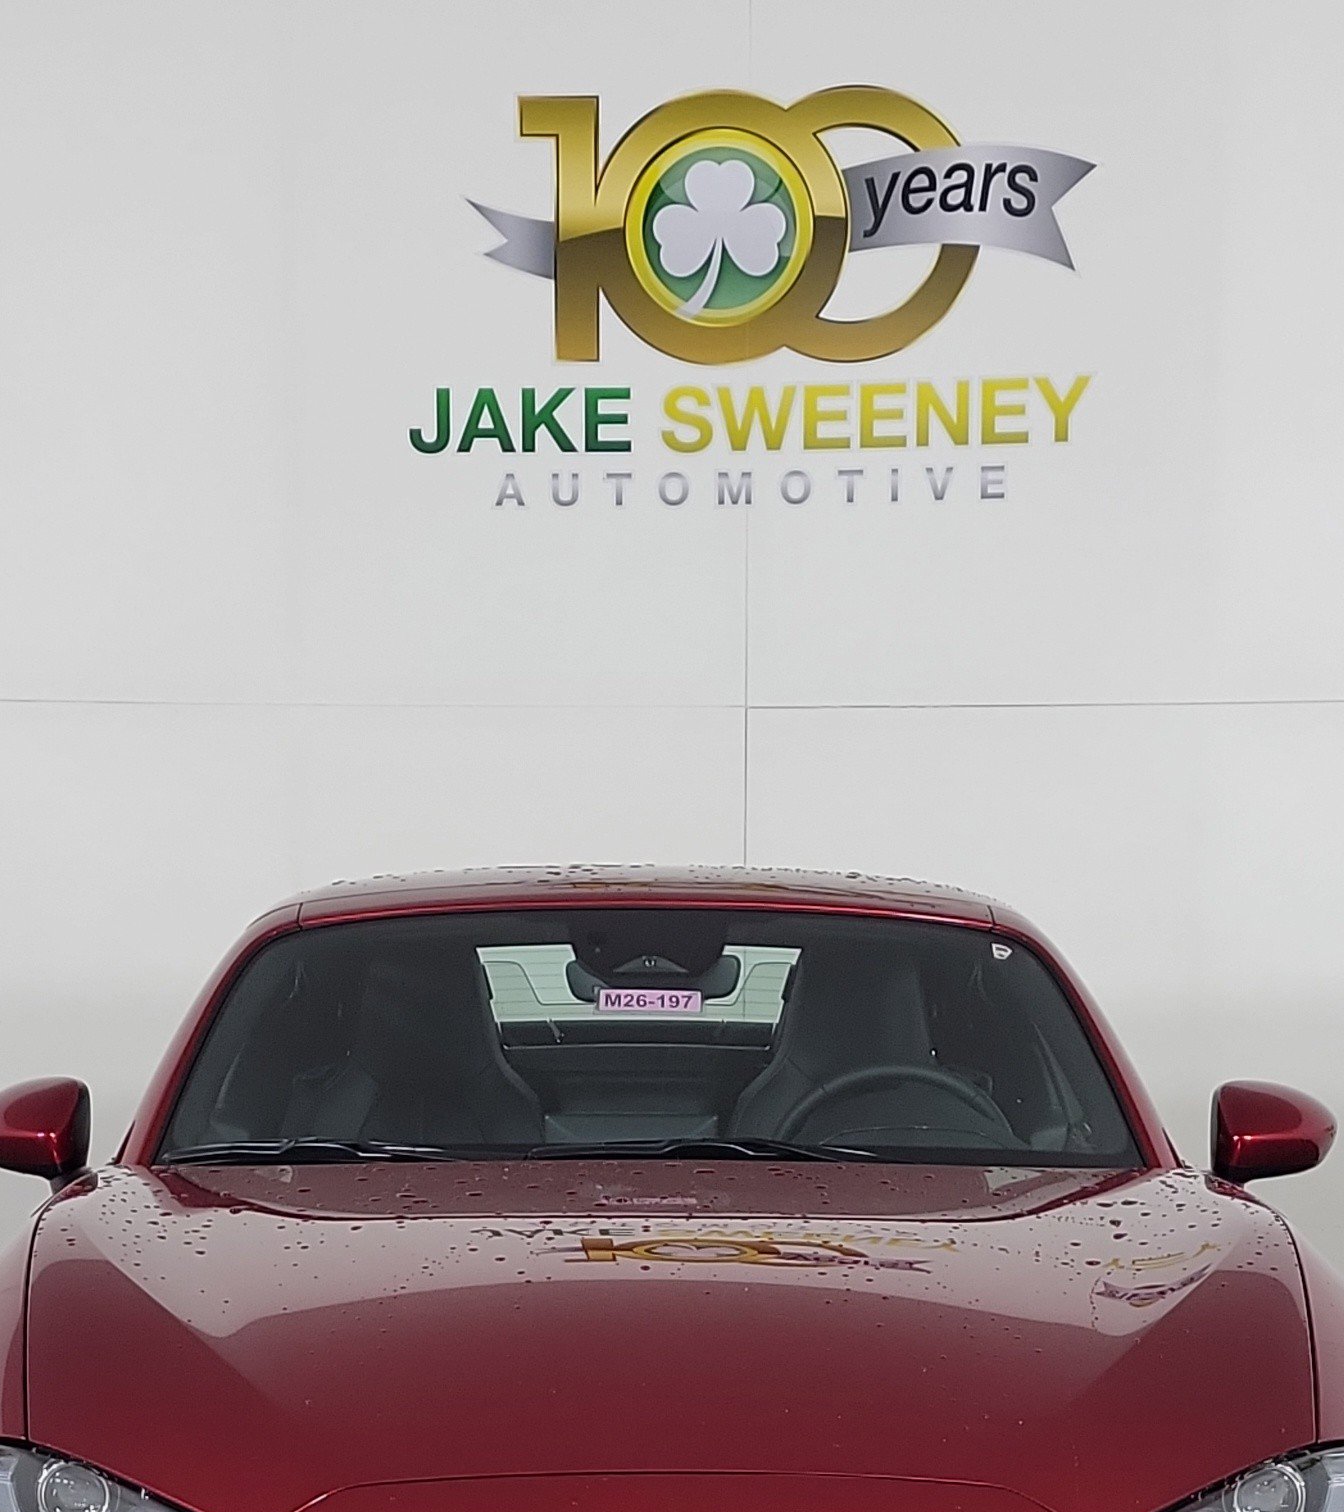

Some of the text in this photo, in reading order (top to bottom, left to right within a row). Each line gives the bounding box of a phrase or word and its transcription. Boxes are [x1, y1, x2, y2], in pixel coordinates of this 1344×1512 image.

[863, 161, 1038, 238] years
[409, 375, 1090, 454] JAKE SWEENEY
[494, 465, 1007, 508] AUTOMOTIVE
[604, 993, 693, 1009] M26-197
